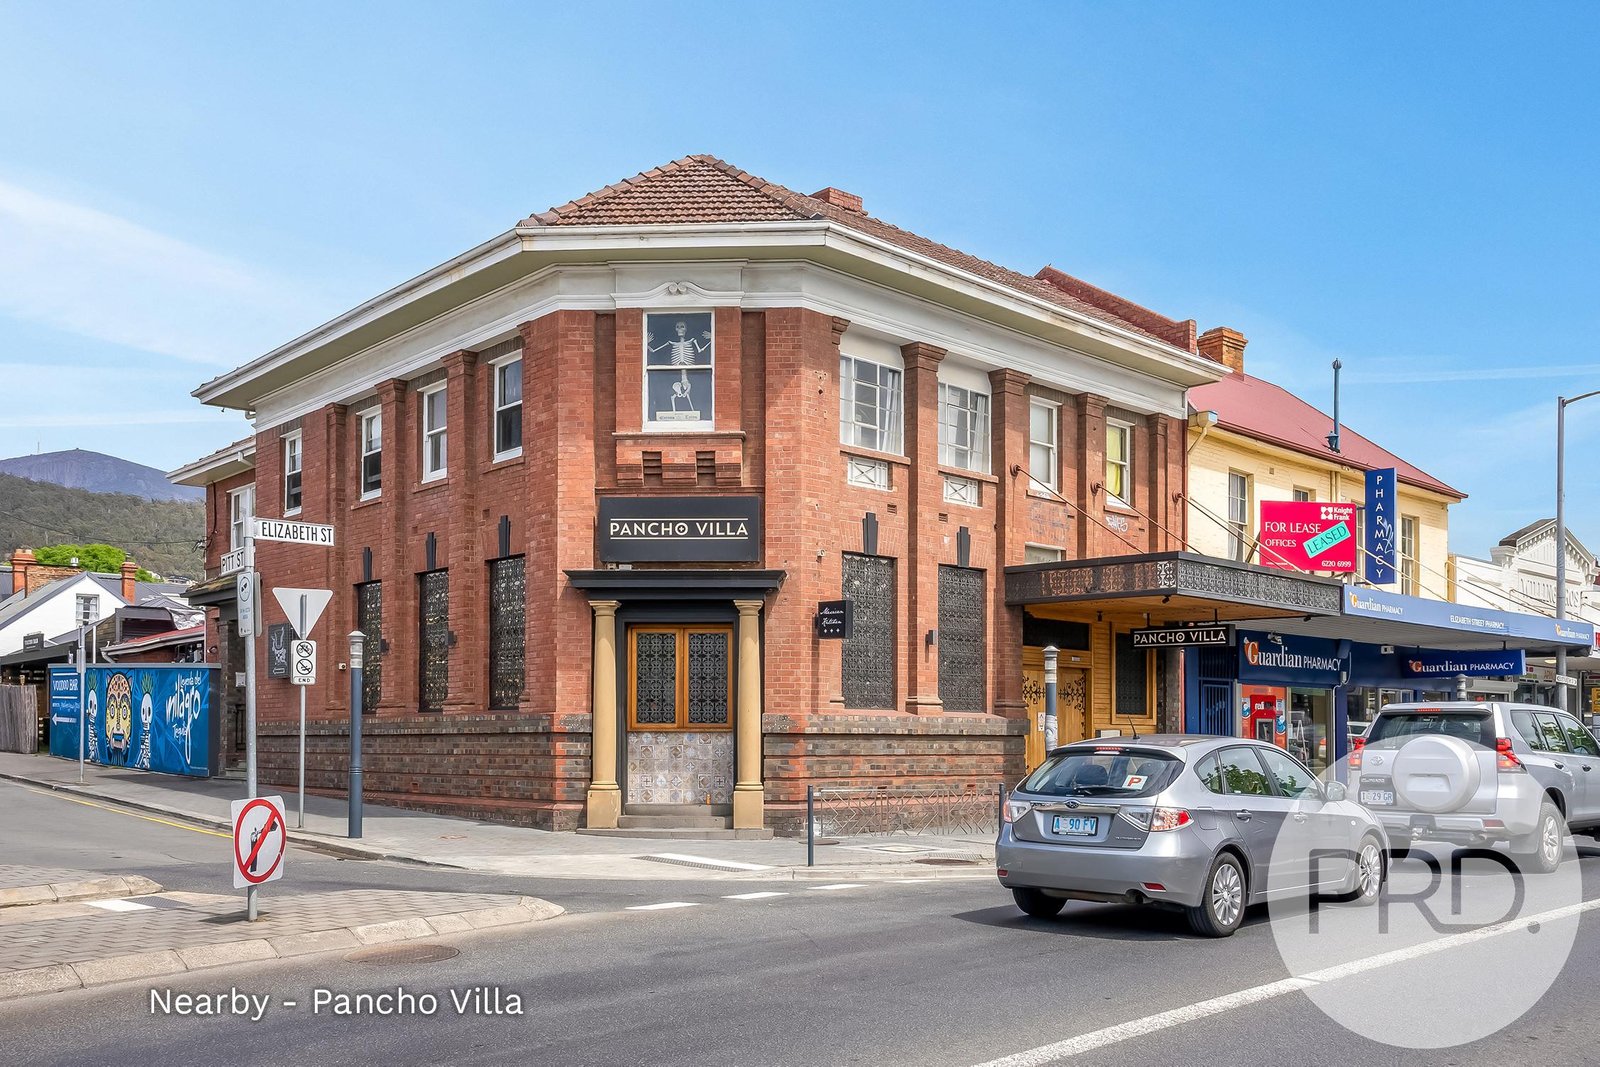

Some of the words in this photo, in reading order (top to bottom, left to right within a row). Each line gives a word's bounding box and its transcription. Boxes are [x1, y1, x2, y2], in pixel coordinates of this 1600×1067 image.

[1333, 507, 1353, 515] Knight
[261, 521, 318, 541] ELIZABETH
[320, 528, 332, 543] ST
[610, 522, 689, 536] PANCHO
[696, 522, 749, 536] VILLA
[1264, 522, 1286, 533] FOR
[1290, 523, 1322, 534] LEASE
[1375, 475, 1385, 578] PHARMACY
[1265, 538, 1297, 548] OFFICES
[1307, 525, 1347, 554] LEASED
[222, 554, 235, 572] PITT
[236, 551, 244, 567] ST
[1337, 560, 1352, 568] 6999
[1351, 594, 1382, 612] Guardian
[1382, 604, 1403, 615] PHARMACY
[1450, 615, 1471, 625] ELIZABETH
[1471, 618, 1485, 627] STREET
[1485, 620, 1504, 629] PHARMACY
[1133, 632, 1185, 644] PANCHO
[1190, 630, 1226, 642] VILLA
[1247, 641, 1302, 668] Guardian
[1303, 655, 1341, 671] PHARMACY
[1411, 660, 1468, 672] Guardian
[1470, 662, 1514, 671] PHARMACY
[1127, 777, 1142, 787] P
[1055, 818, 1060, 827] A
[1069, 818, 1080, 830] 90
